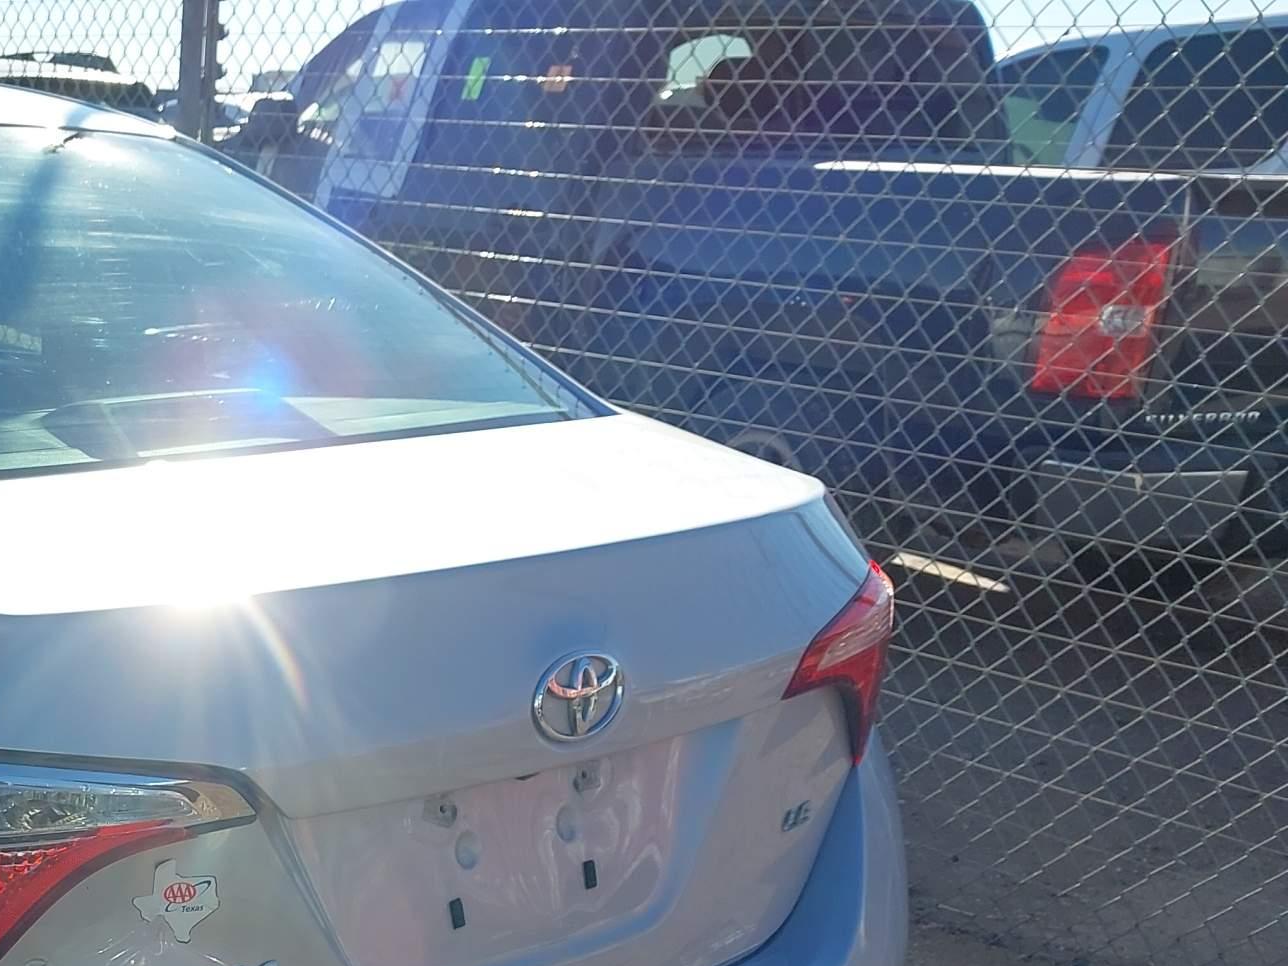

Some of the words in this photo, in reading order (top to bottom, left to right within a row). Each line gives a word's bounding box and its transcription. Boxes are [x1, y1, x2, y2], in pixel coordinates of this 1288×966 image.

[781, 799, 810, 832] LE
[166, 884, 194, 903] AAA
[180, 904, 204, 913] Texas
